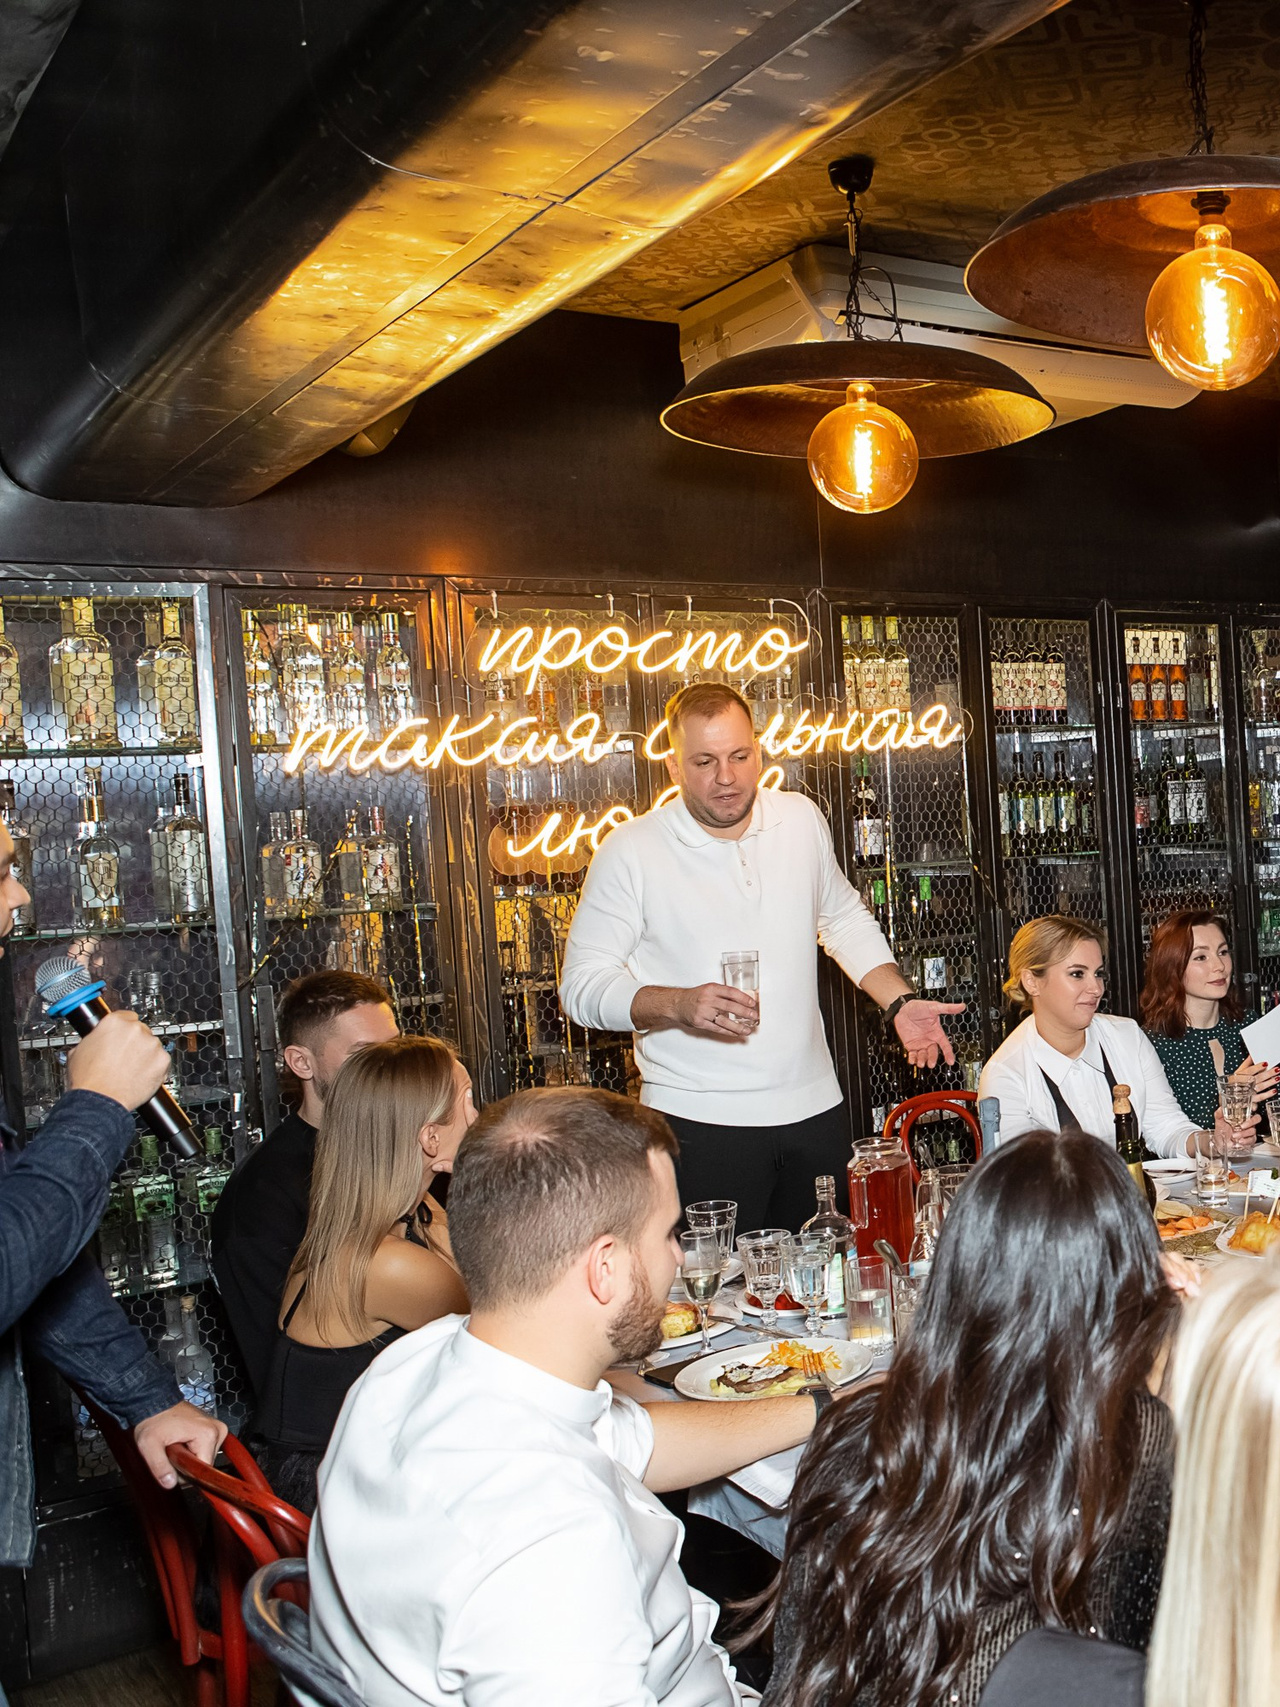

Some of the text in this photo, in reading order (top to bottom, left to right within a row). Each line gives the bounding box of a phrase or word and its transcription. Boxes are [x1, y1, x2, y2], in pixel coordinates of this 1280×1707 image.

[479, 626, 809, 694] просто
[285, 704, 962, 772] такая сльная
